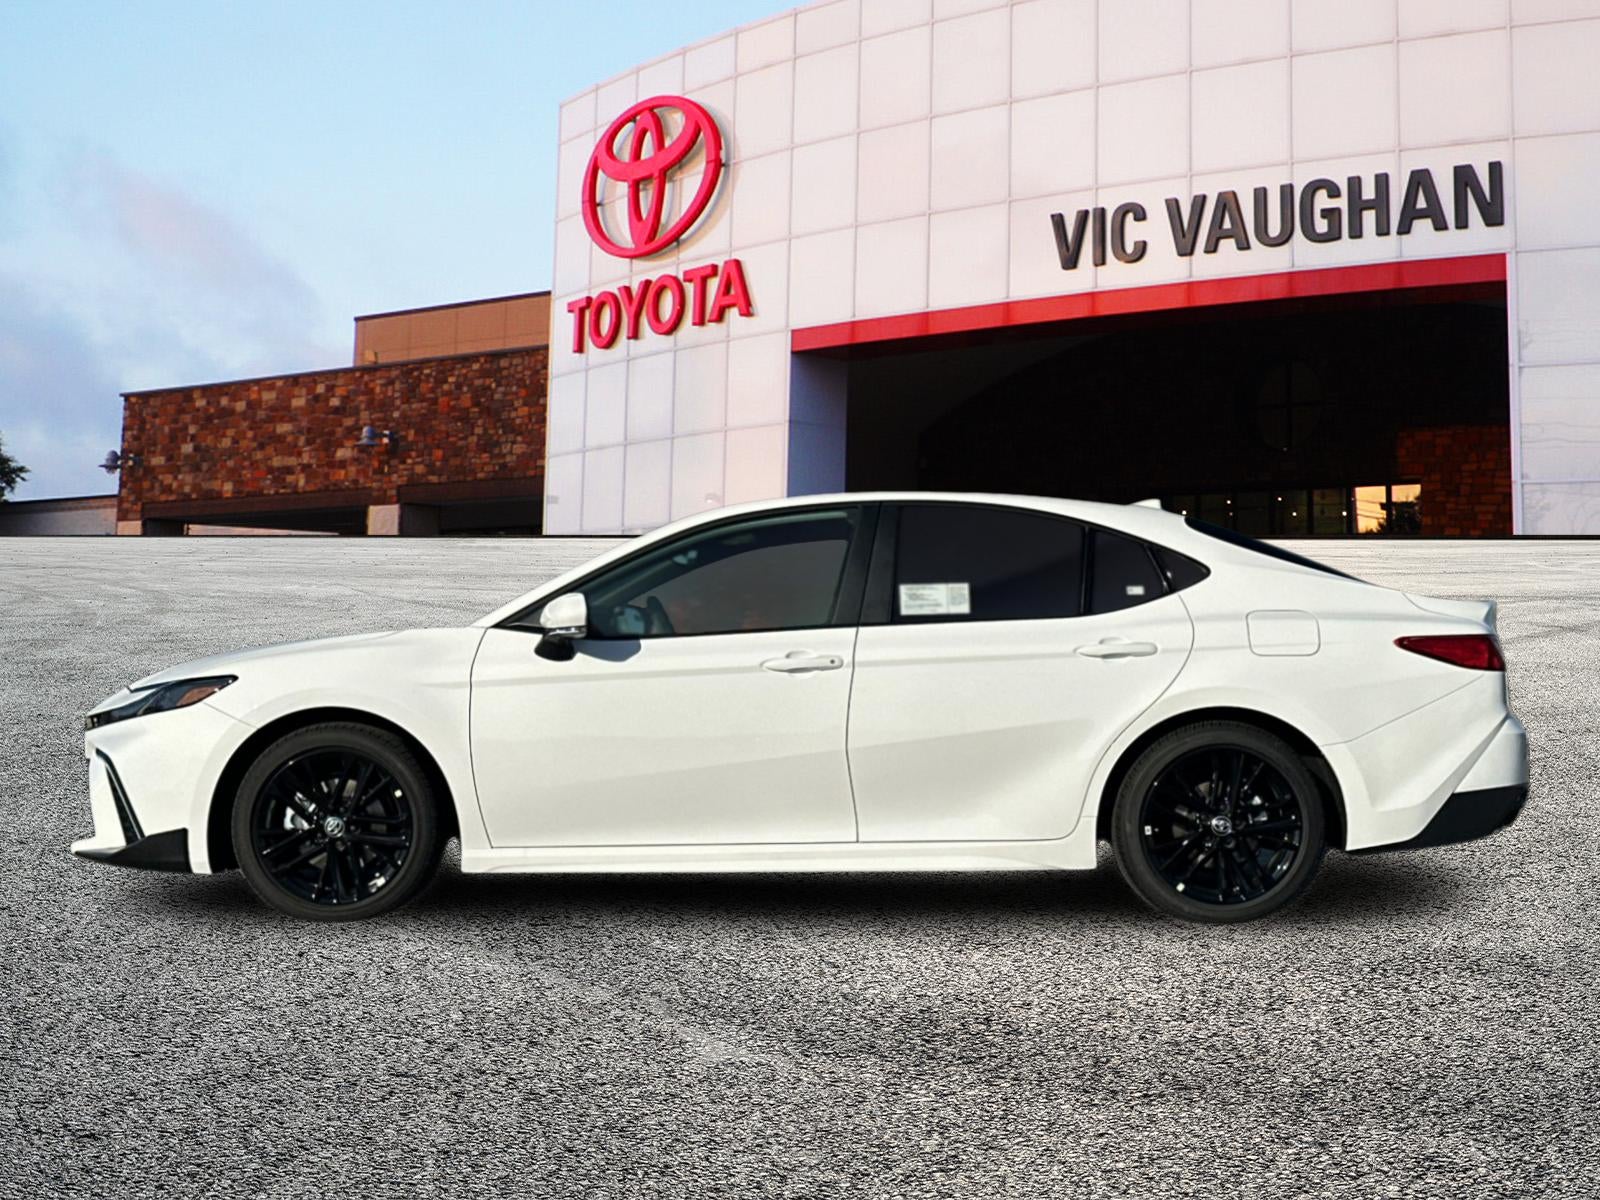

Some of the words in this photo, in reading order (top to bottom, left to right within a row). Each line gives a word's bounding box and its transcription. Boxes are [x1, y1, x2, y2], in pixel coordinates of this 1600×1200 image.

[1050, 201, 1148, 271] VIC
[1165, 160, 1505, 257] VAUGHAN
[567, 258, 754, 354] TOYOTA
